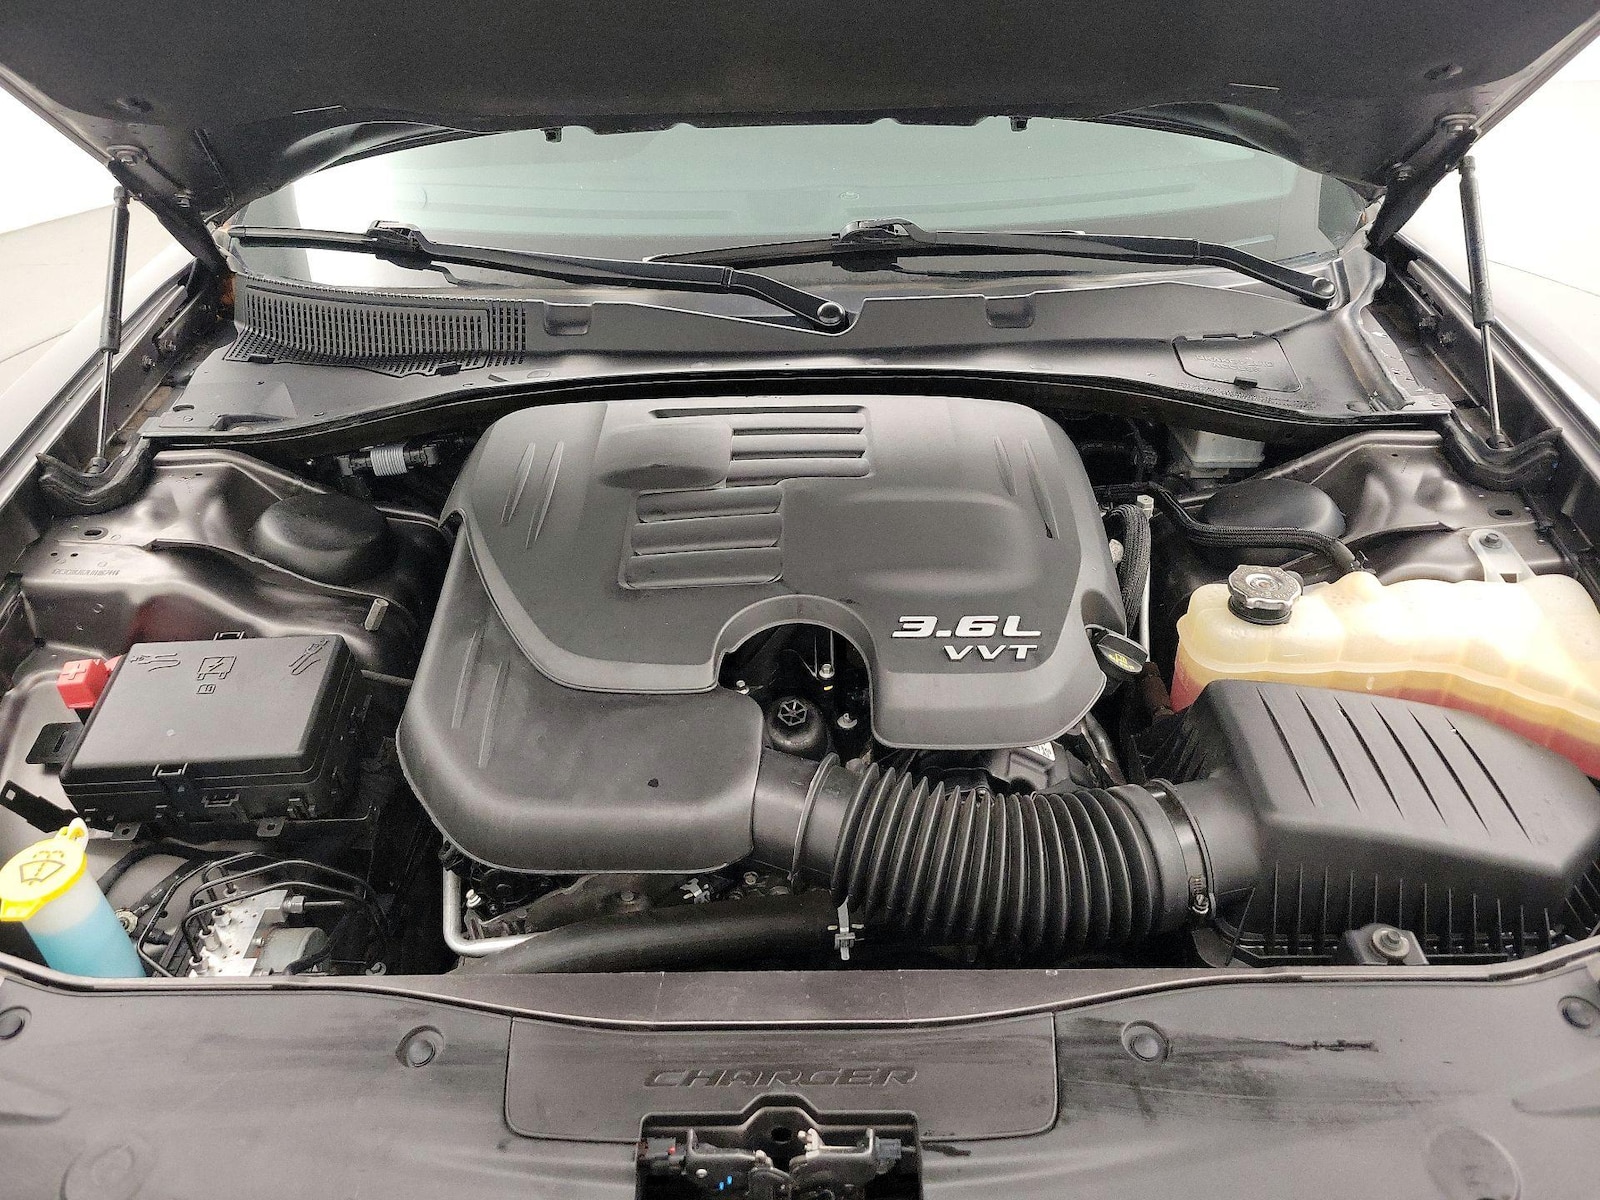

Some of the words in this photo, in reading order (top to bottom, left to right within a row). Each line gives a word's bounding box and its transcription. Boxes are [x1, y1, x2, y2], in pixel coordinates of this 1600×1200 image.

[892, 615, 1041, 638] 3.6L
[943, 644, 1038, 661] VVT
[644, 1067, 918, 1087] CHARGER
